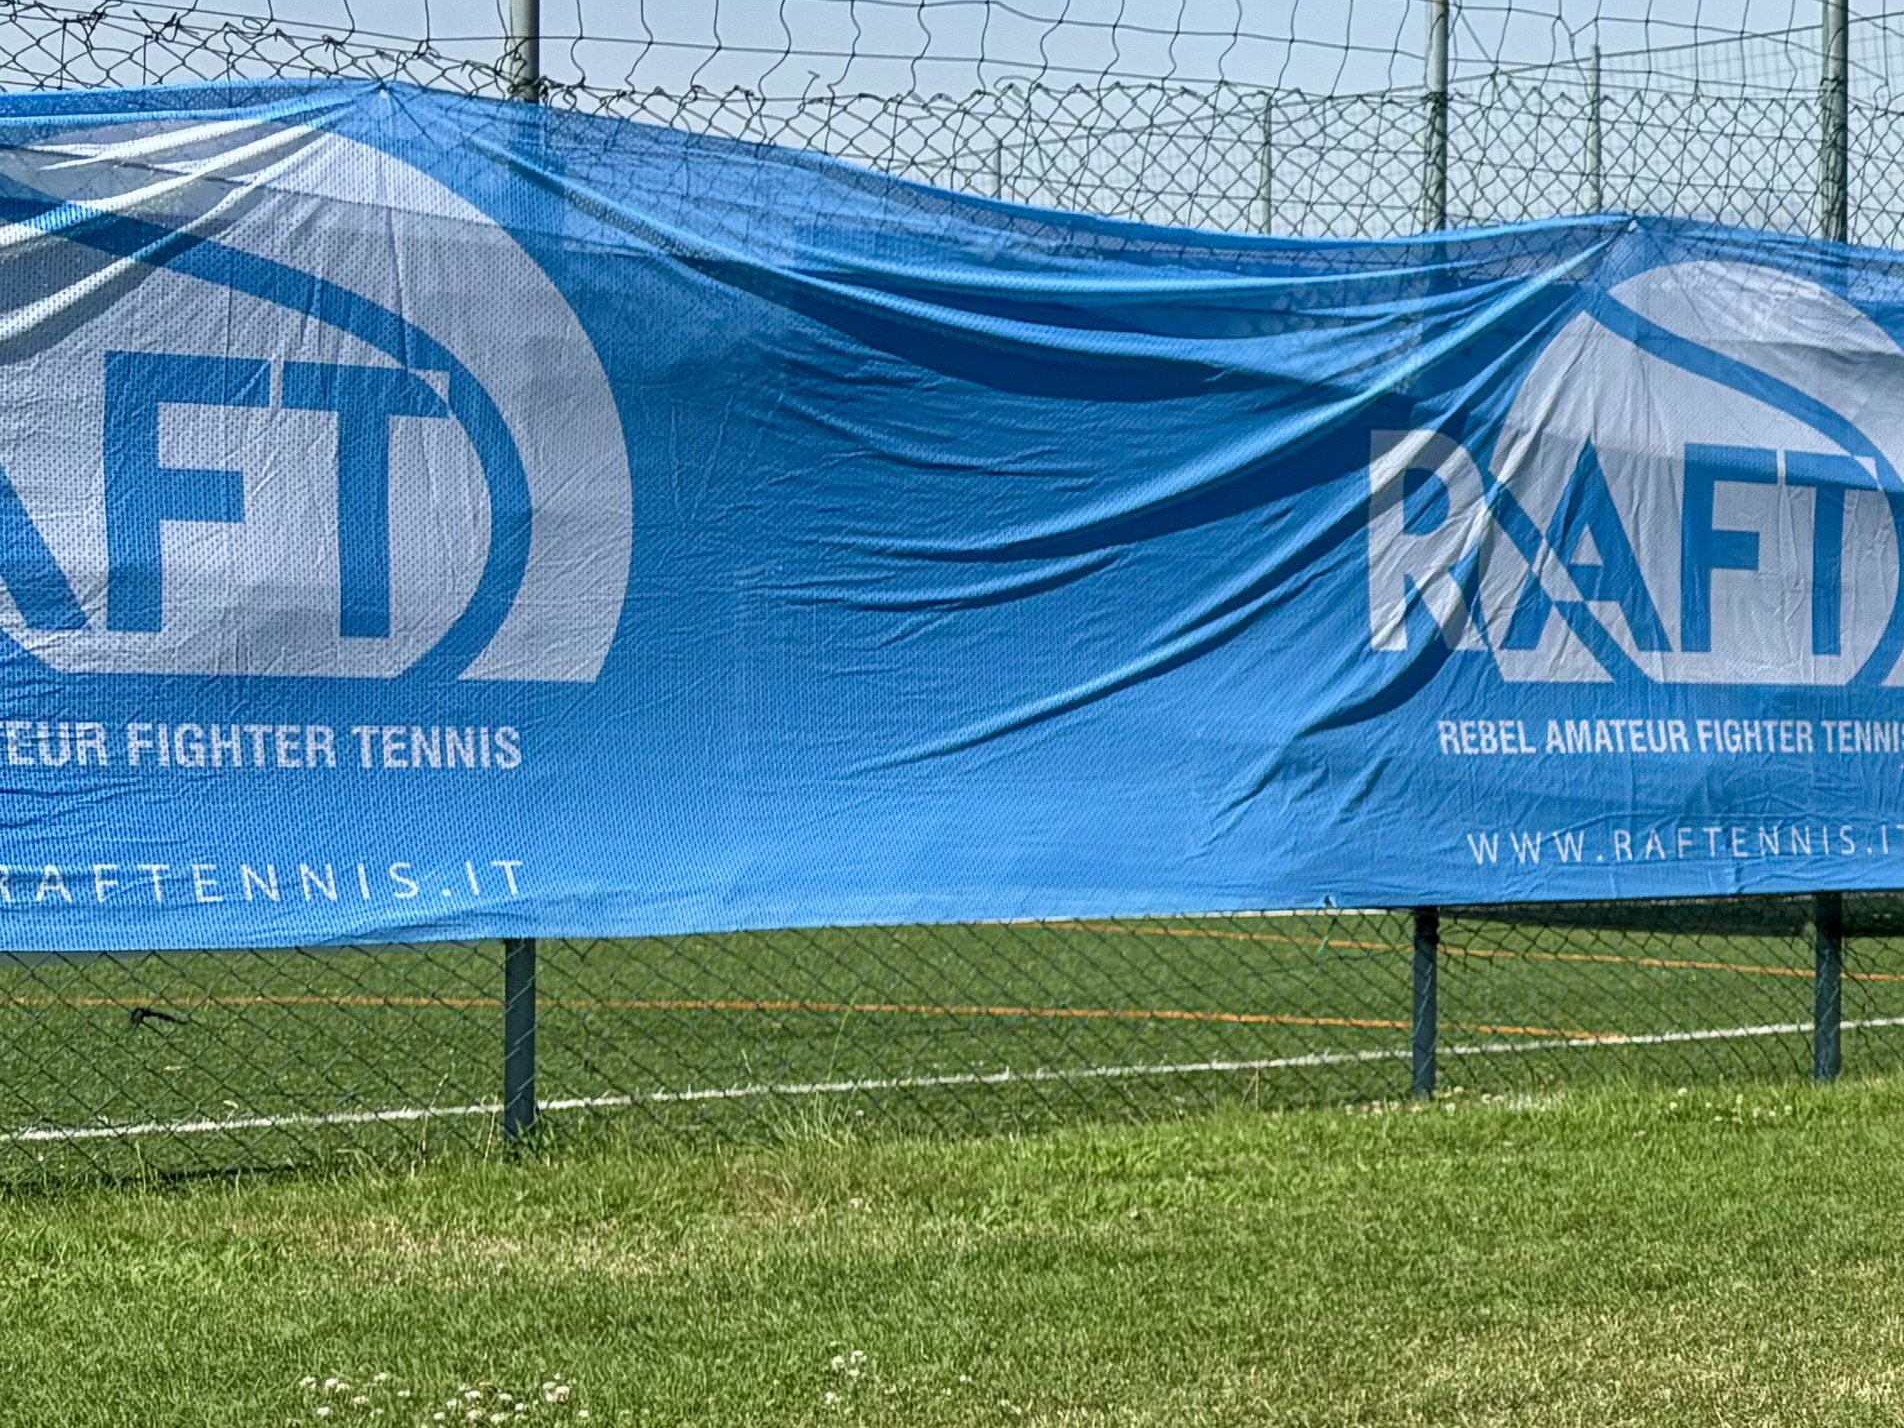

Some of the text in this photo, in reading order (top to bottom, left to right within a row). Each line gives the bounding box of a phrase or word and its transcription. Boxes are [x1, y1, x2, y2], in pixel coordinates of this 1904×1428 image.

[1369, 428, 1885, 656] RAFT
[0, 721, 522, 769] EUR FIGHTER TENNIS
[1438, 720, 1536, 755] REBEL
[1545, 719, 1690, 754] AMATEUR
[1697, 719, 1814, 754] FIGHTER
